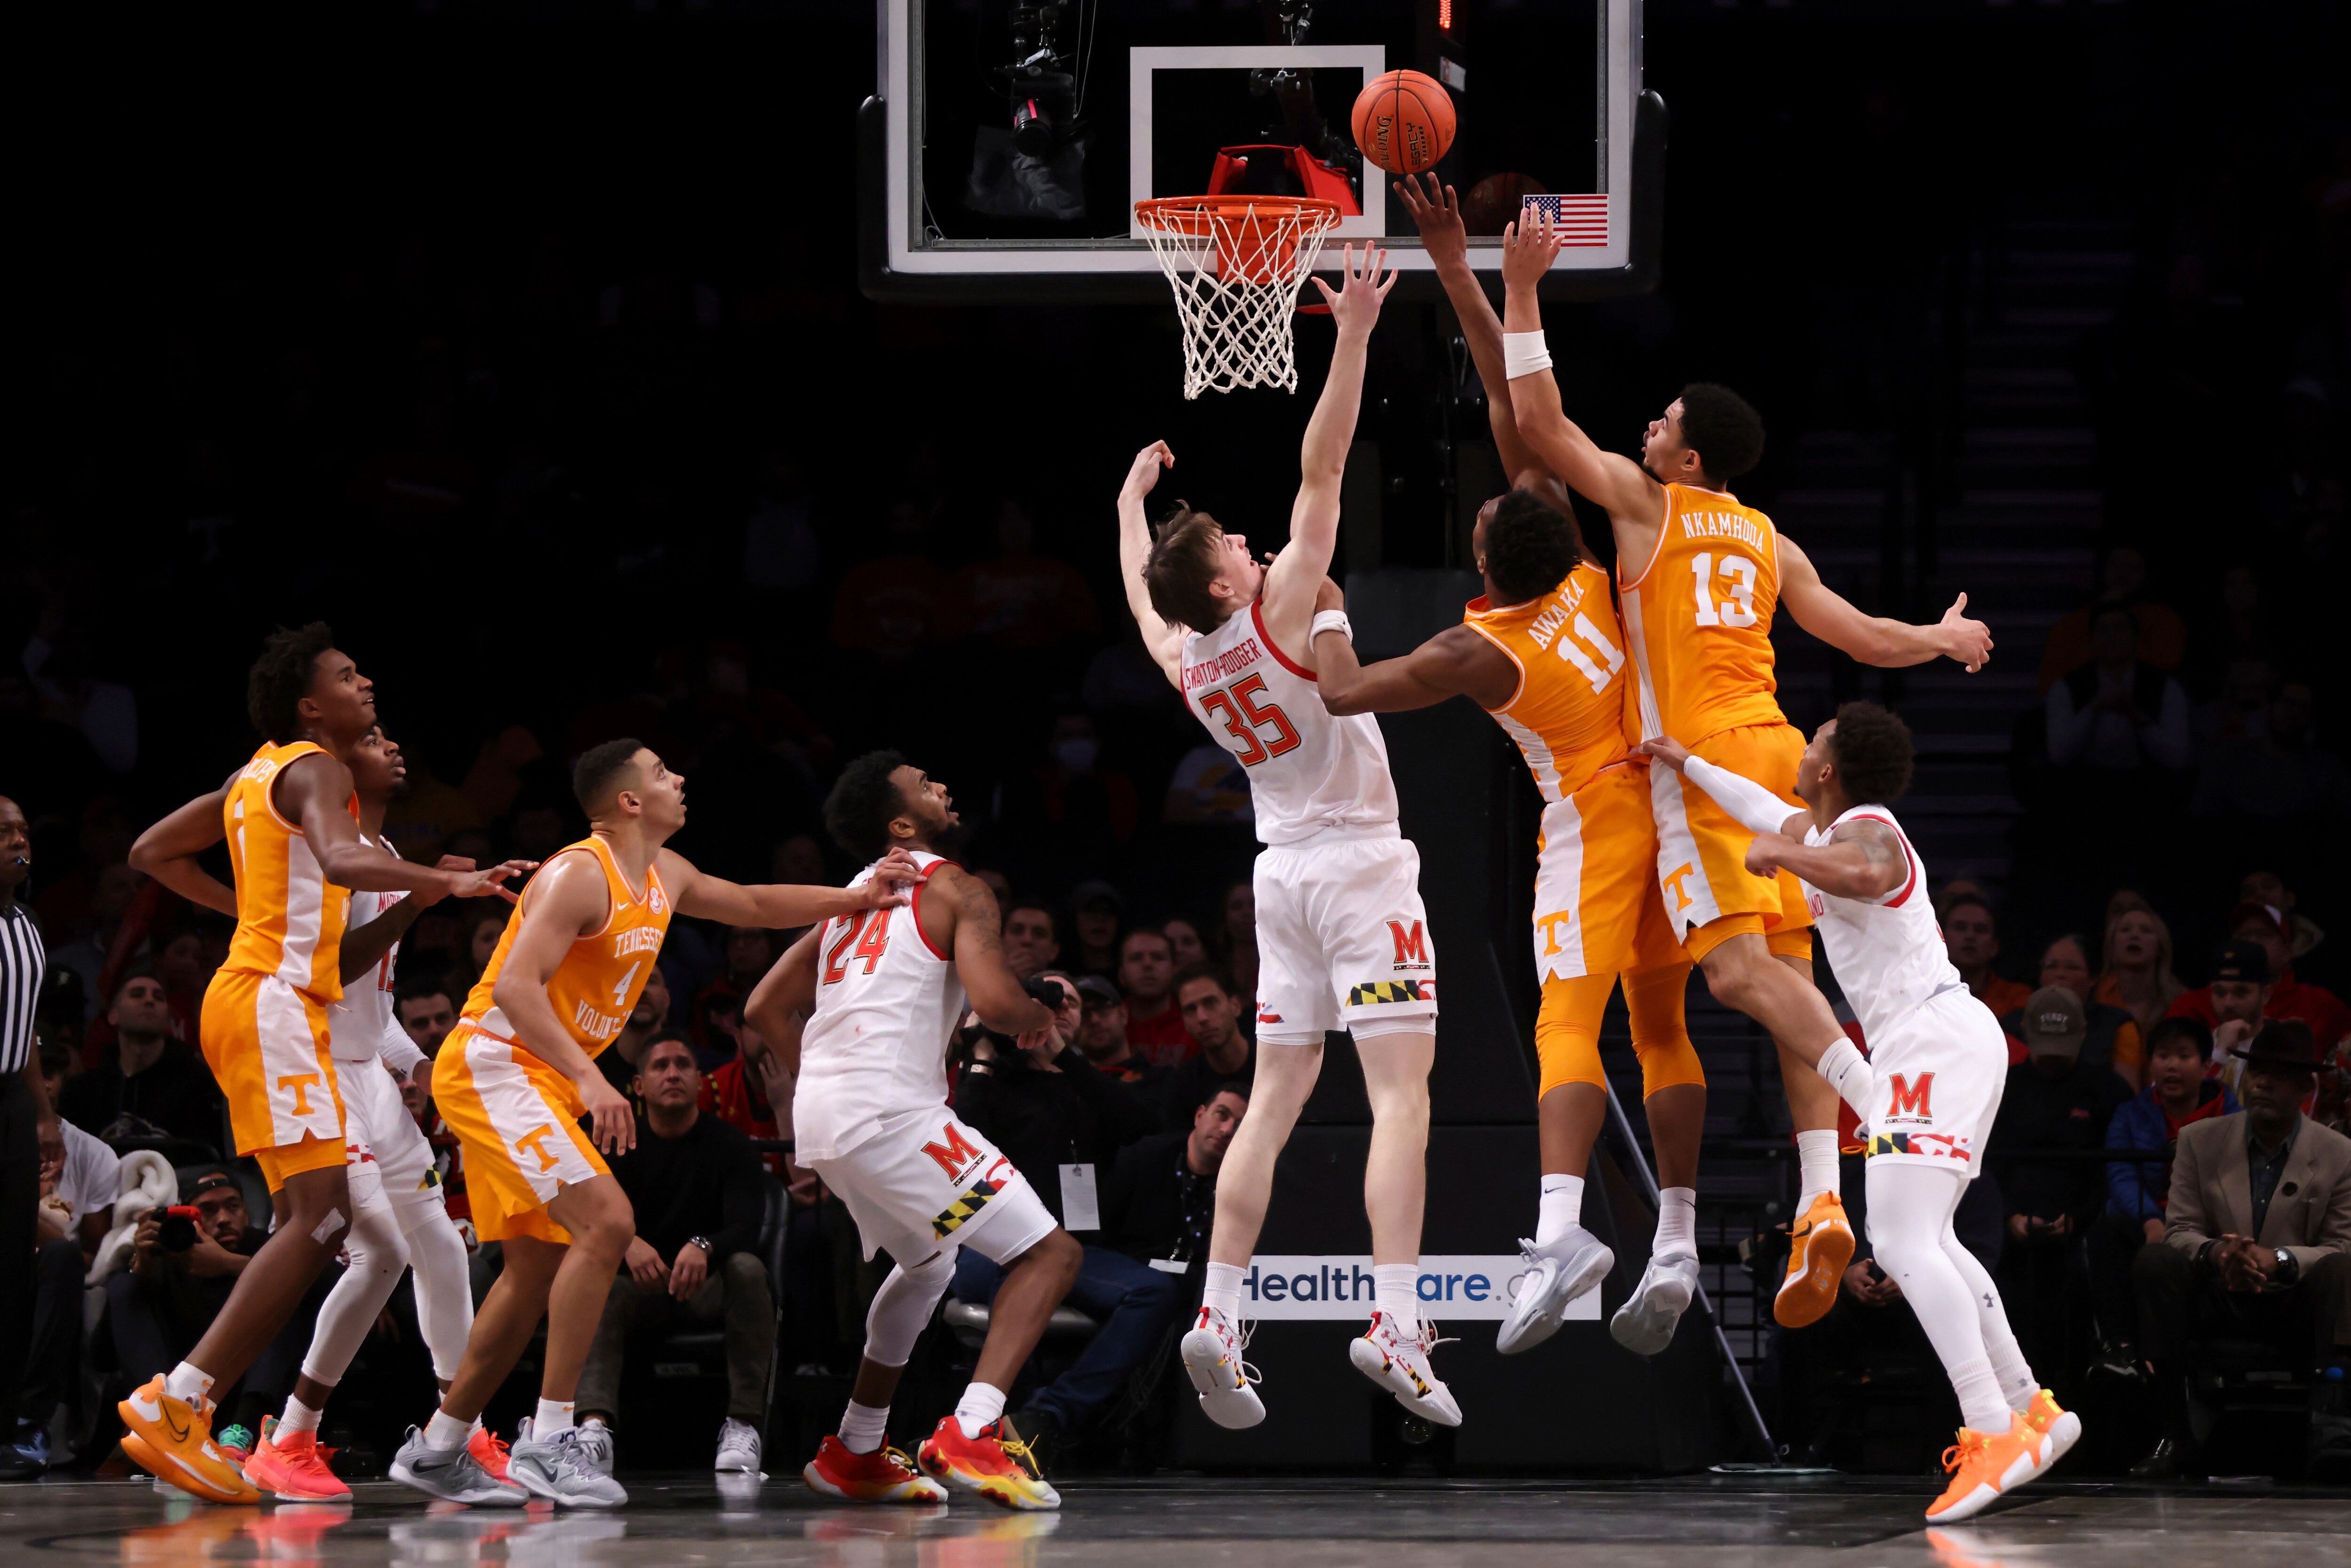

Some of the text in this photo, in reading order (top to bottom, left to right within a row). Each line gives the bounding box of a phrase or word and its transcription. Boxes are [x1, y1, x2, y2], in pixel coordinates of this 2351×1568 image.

[1377, 115, 1395, 171] PALDING
[1680, 512, 1764, 554] NKAMHOUA
[1528, 576, 1585, 651] AWAKA
[1691, 552, 1758, 627] 13
[1557, 611, 1625, 696] 11
[1199, 671, 1302, 767] 35
[1663, 861, 1694, 913] T
[823, 906, 895, 986] 24
[1386, 920, 1429, 964] M
[1537, 910, 1569, 956] T
[613, 961, 641, 1005] 4
[277, 1073, 320, 1116] T
[1886, 1072, 1935, 1118] M
[515, 1123, 560, 1173] T
[920, 1121, 982, 1182] M
